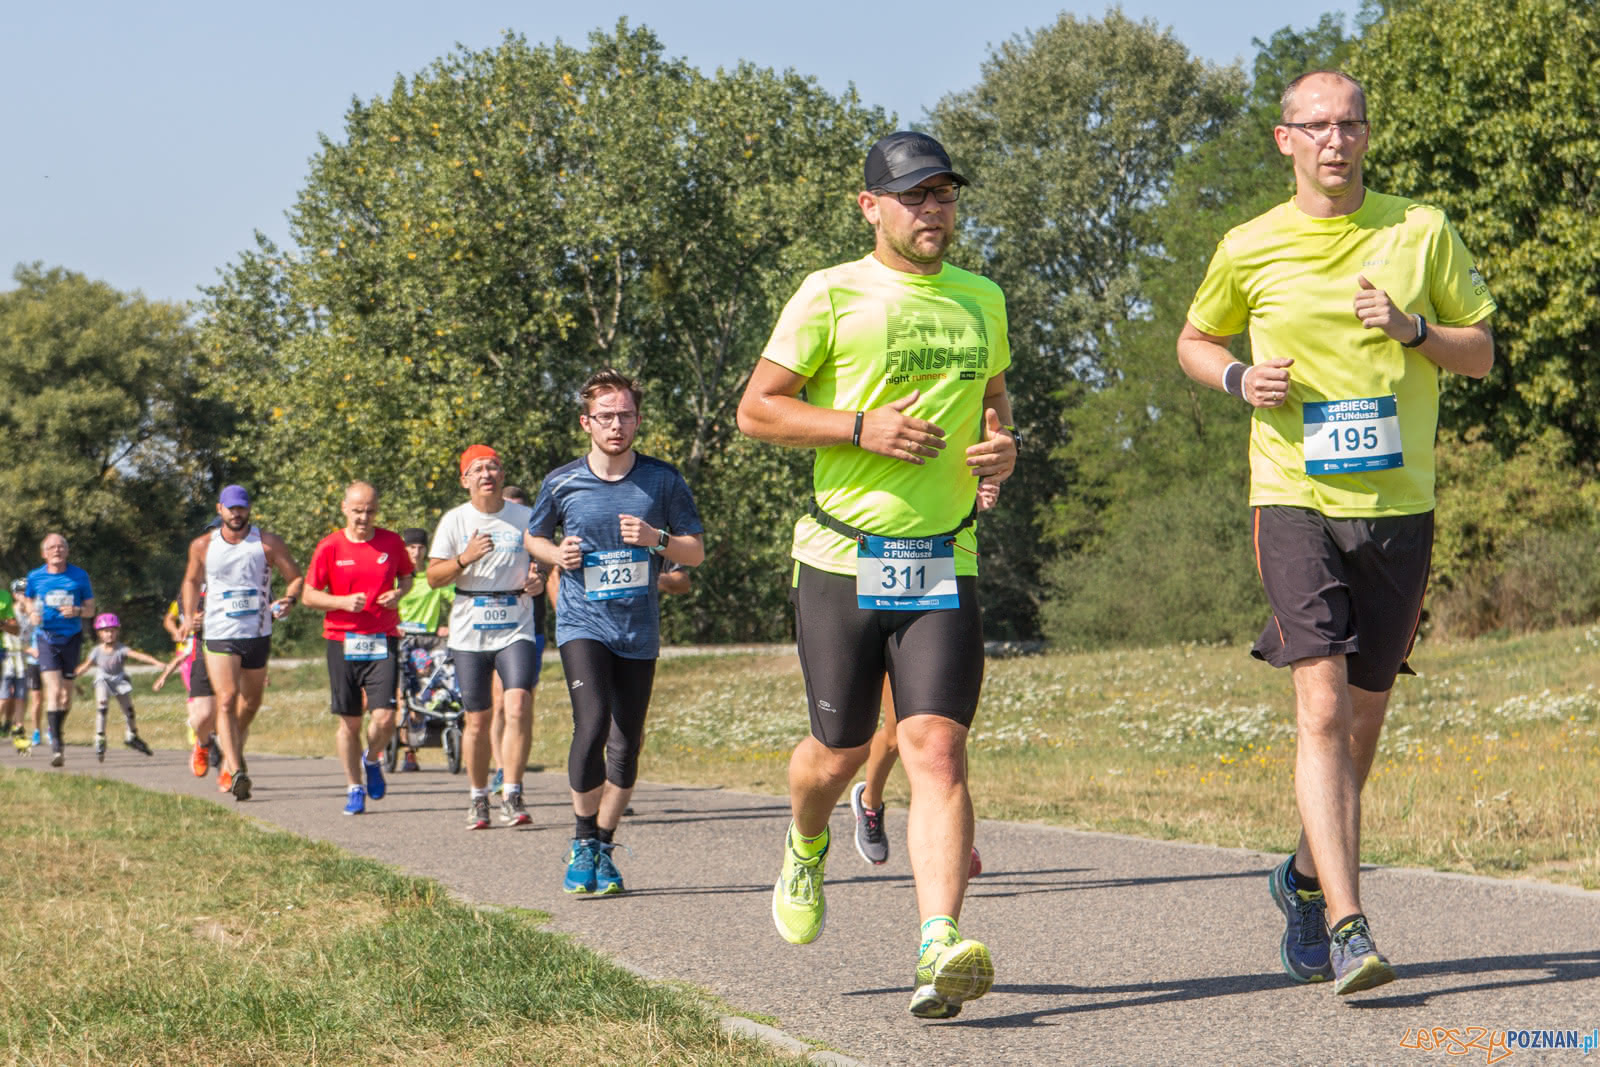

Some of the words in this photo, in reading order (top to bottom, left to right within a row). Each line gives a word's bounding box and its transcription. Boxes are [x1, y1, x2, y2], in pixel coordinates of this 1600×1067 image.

[886, 347, 989, 373] FINISHER
[886, 373, 909, 384] night
[912, 372, 947, 382] runners
[1328, 400, 1379, 413] zaBIEGaj
[1336, 412, 1379, 421] FUNdusze
[1328, 426, 1378, 452] 195
[884, 540, 933, 551] zaBIEGaj
[891, 550, 932, 558] FUNdusze
[600, 568, 632, 585] 423
[881, 565, 926, 590] 311
[484, 609, 507, 621] 009
[355, 641, 377, 652] 495
